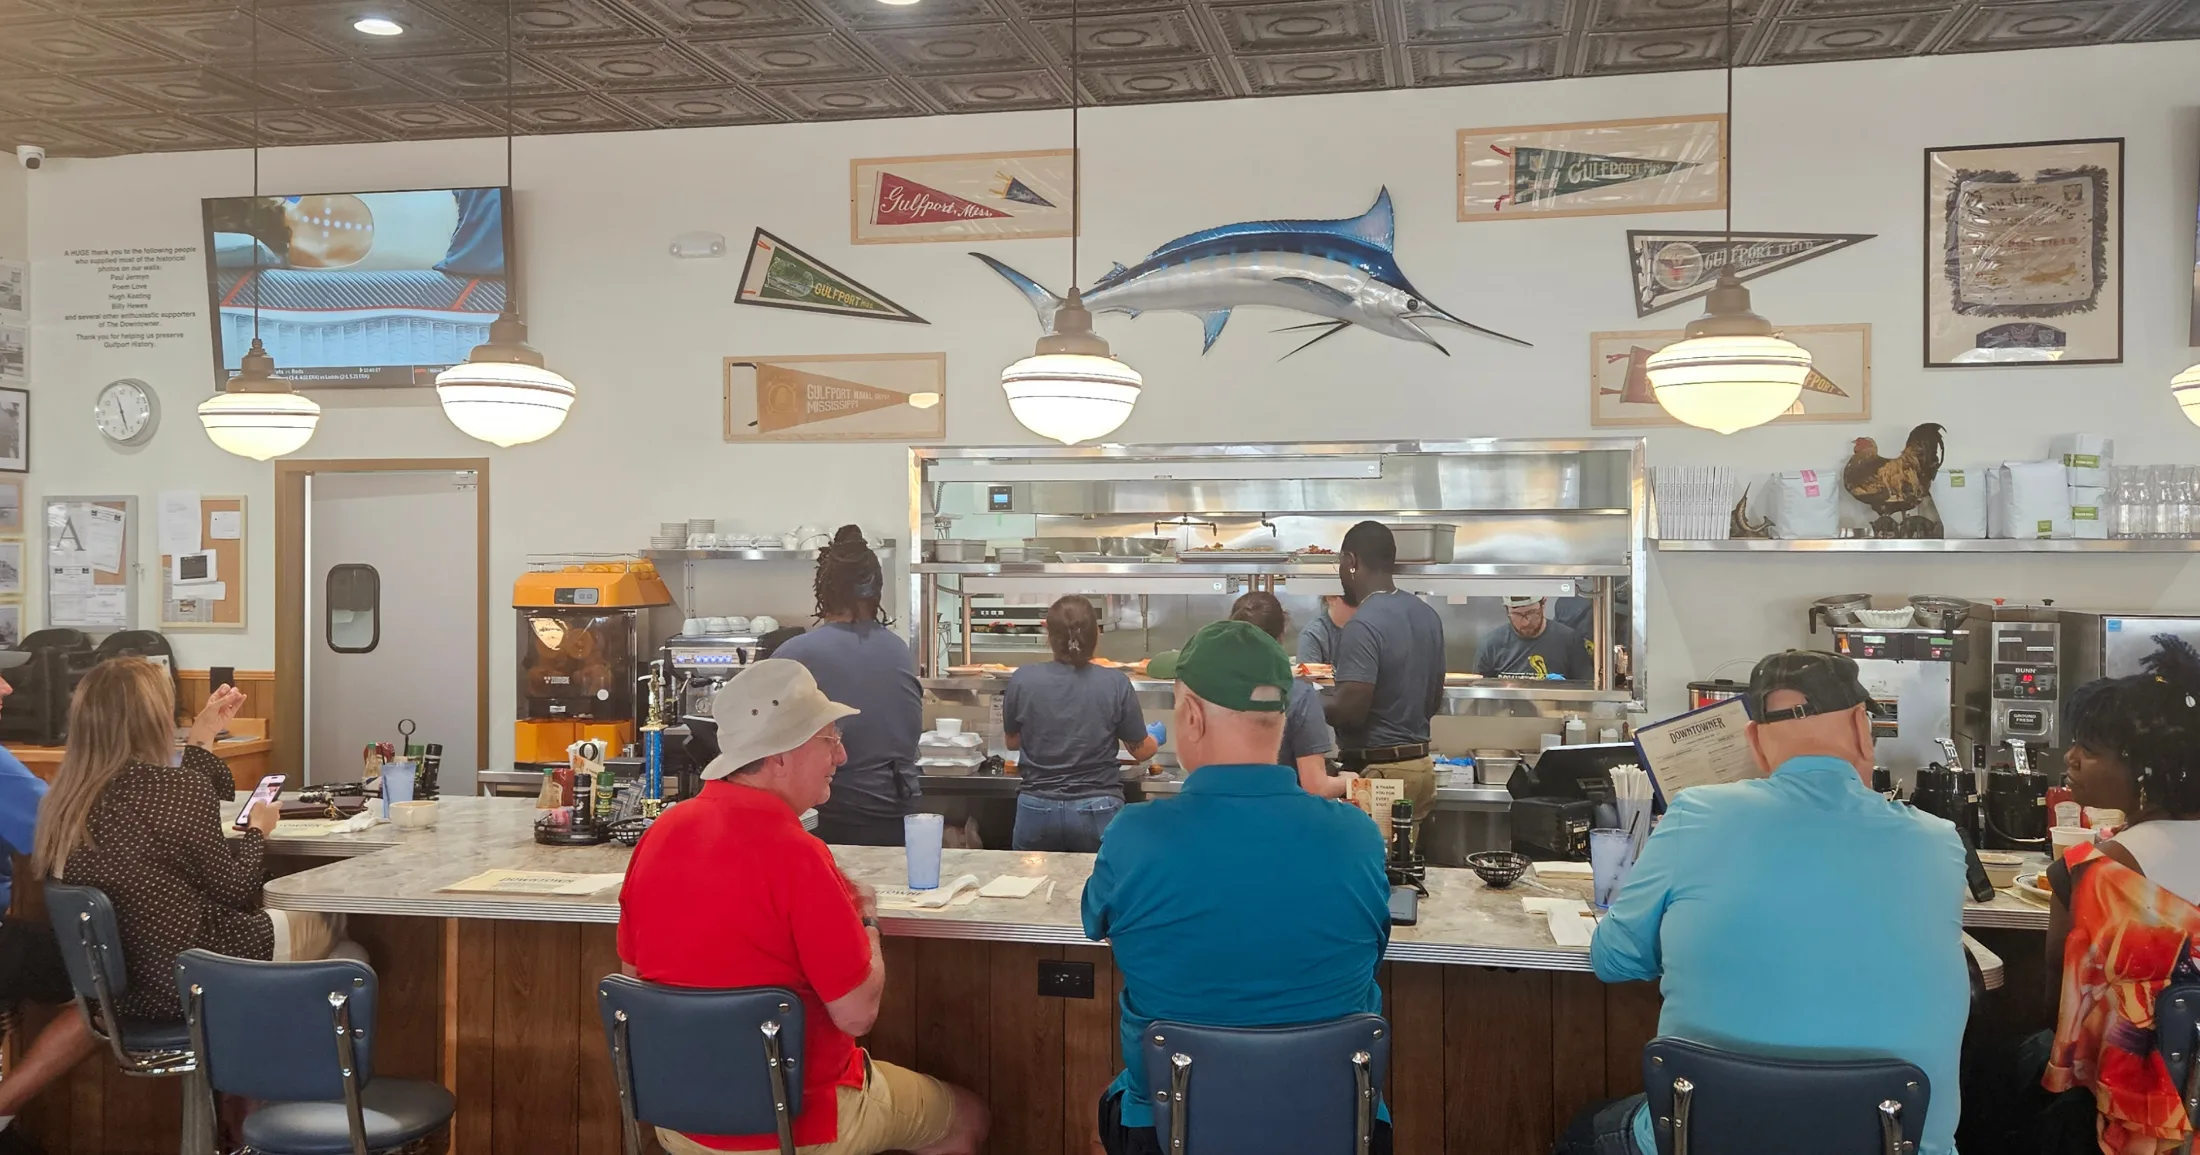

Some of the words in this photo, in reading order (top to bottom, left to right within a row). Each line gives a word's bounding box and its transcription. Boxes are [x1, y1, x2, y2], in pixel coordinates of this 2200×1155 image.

[880, 186, 957, 218] Gulfport,
[144, 247, 173, 255] following
[98, 265, 120, 273] photos
[814, 282, 861, 306] GULFPORT
[160, 311, 196, 319] supporters
[120, 332, 144, 340] helping
[1806, 372, 1836, 392] FPORT
[807, 384, 851, 400] GULFPORT
[807, 400, 859, 414] MISSISSIPPI
[52, 515, 87, 552] A
[1669, 717, 1726, 744] DOWNTOWNER
